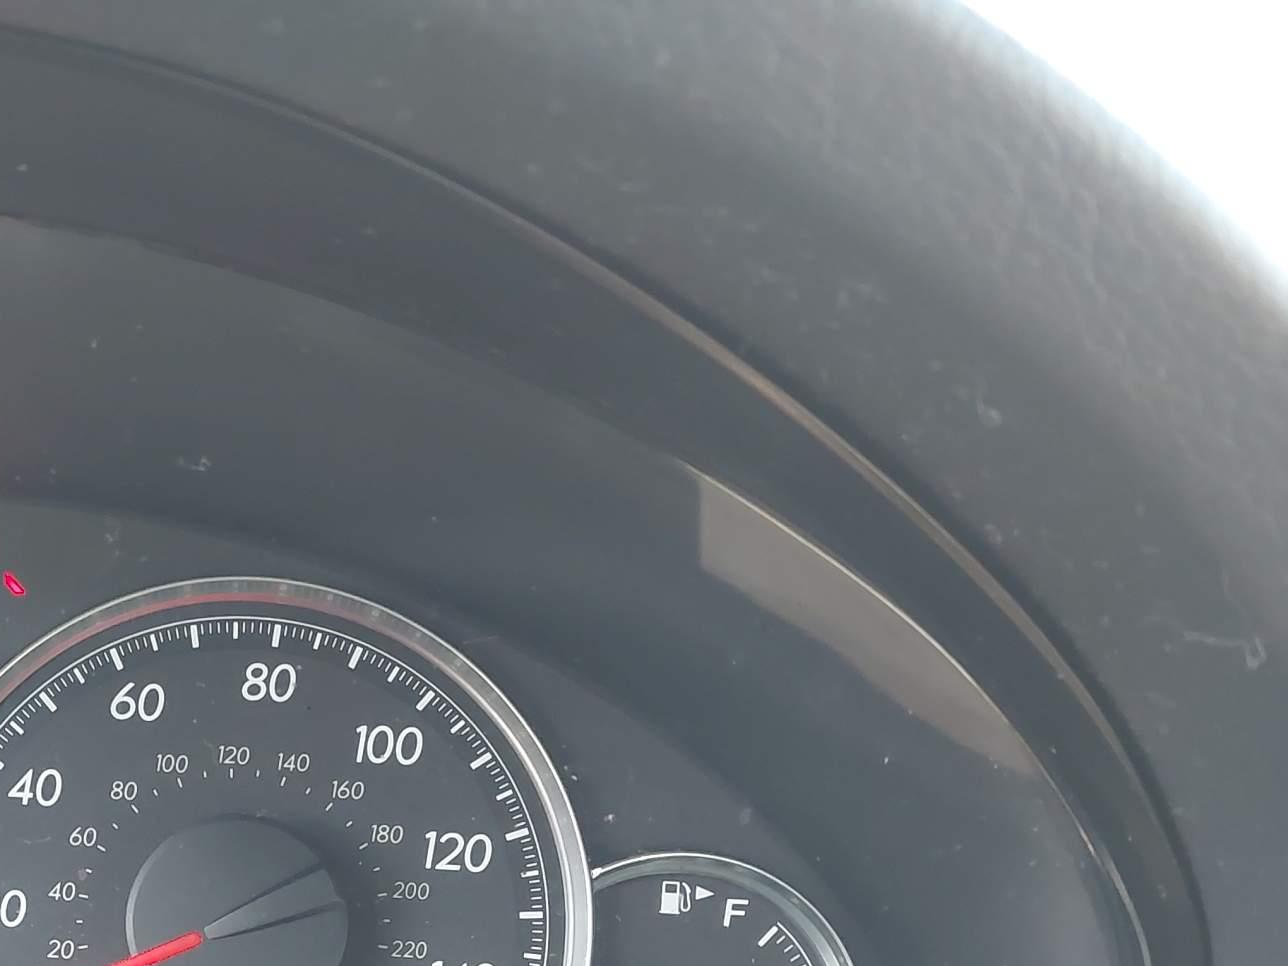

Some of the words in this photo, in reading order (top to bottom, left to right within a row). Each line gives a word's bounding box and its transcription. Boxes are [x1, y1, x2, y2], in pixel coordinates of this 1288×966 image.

[242, 663, 296, 702] 80
[111, 683, 164, 721] 60
[220, 746, 249, 764] 120
[357, 726, 422, 765] 100
[157, 755, 188, 773] 100
[279, 753, 309, 771] 140
[8, 769, 61, 806] 40
[111, 781, 137, 800] 80
[333, 781, 364, 799] 160
[70, 827, 96, 846] 60
[372, 825, 403, 843] 180
[426, 832, 492, 872] 120
[49, 883, 75, 900] 40
[394, 882, 429, 899] 200
[724, 899, 748, 927] F
[48, 940, 74, 959] 20
[392, 941, 427, 958] 220
